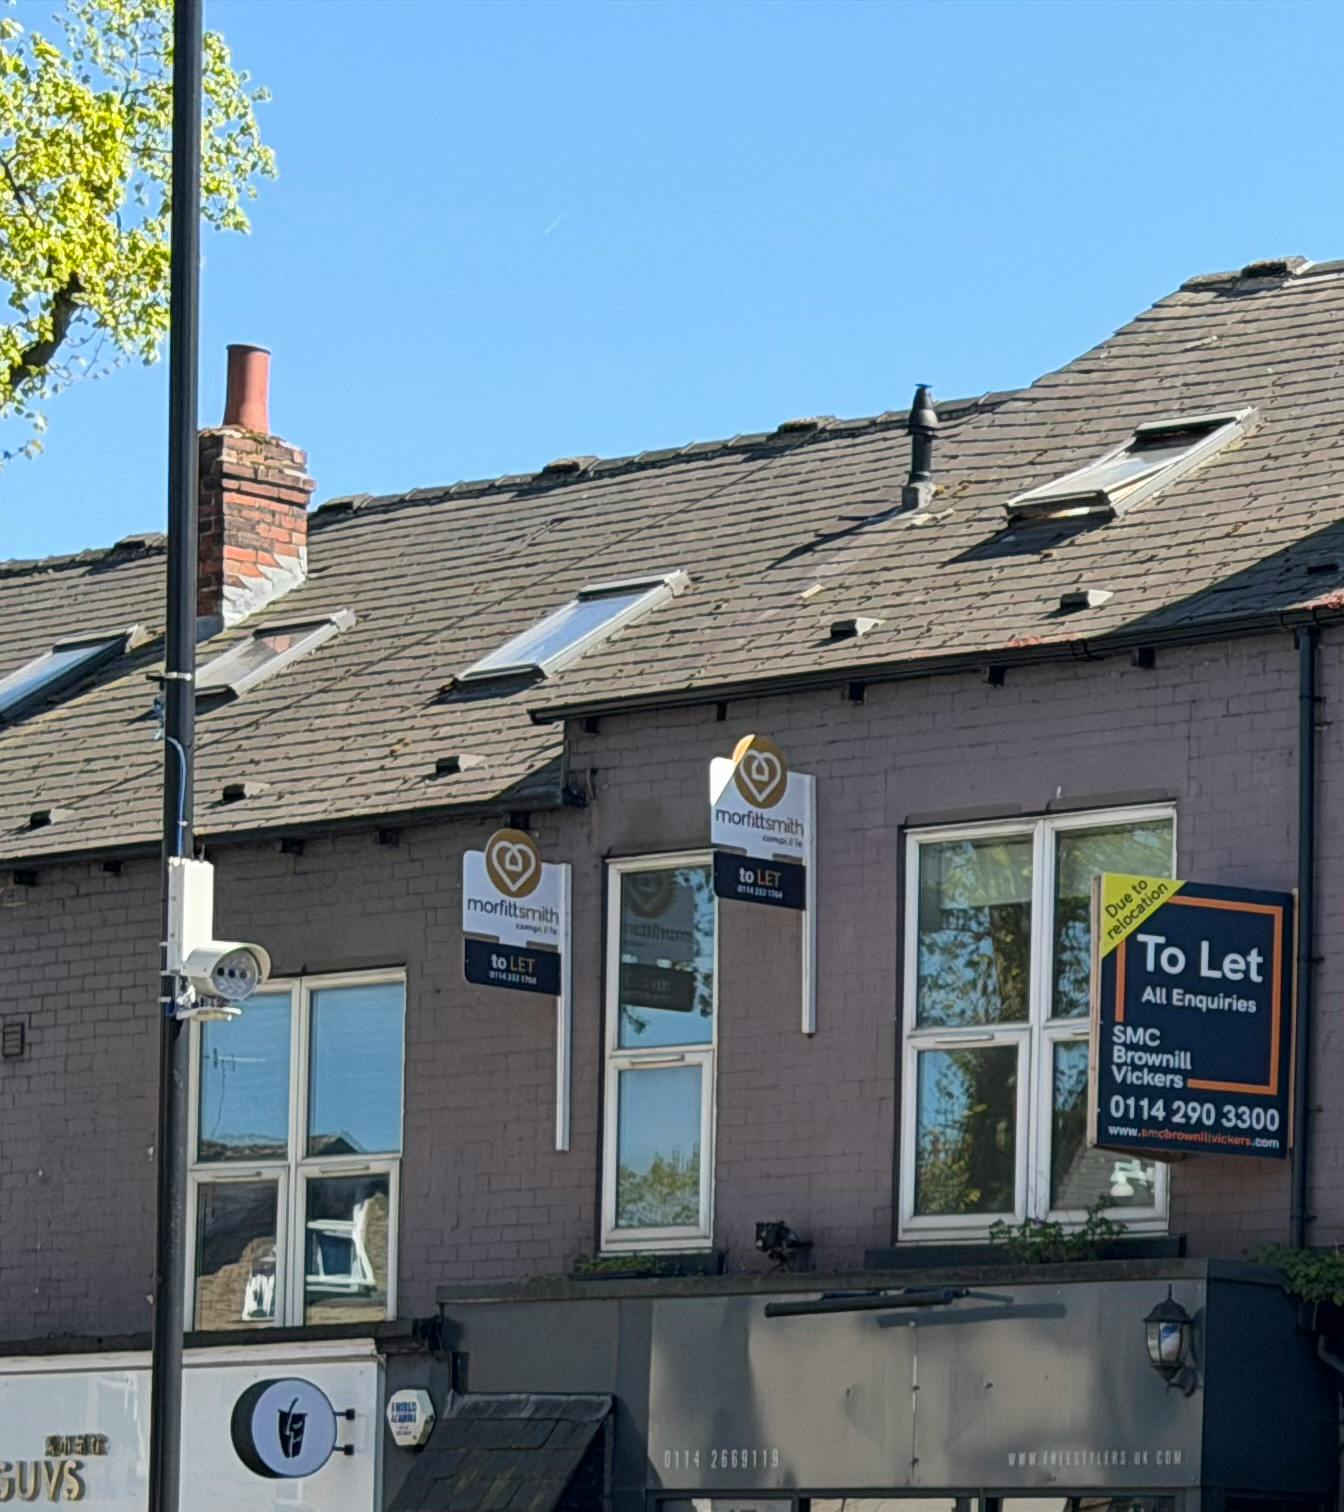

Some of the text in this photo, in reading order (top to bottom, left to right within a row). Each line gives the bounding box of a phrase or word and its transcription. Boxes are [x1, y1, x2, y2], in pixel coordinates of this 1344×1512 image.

[715, 808, 805, 836] morfittsmith
[740, 867, 782, 888] to LET
[467, 898, 559, 926] morfittsmith
[1105, 879, 1148, 919] Due to
[1106, 882, 1168, 941] relocation
[491, 953, 536, 973] to LET
[1136, 933, 1264, 984] To Let
[1141, 986, 1257, 1013] All Enquiries
[1112, 1025, 1161, 1047] SMC
[1113, 1045, 1192, 1070] Brownill
[1111, 1066, 1184, 1089] Vickers
[1110, 1095, 1279, 1132] 0114 290 3300
[664, 1448, 779, 1469] 0114 2669119
